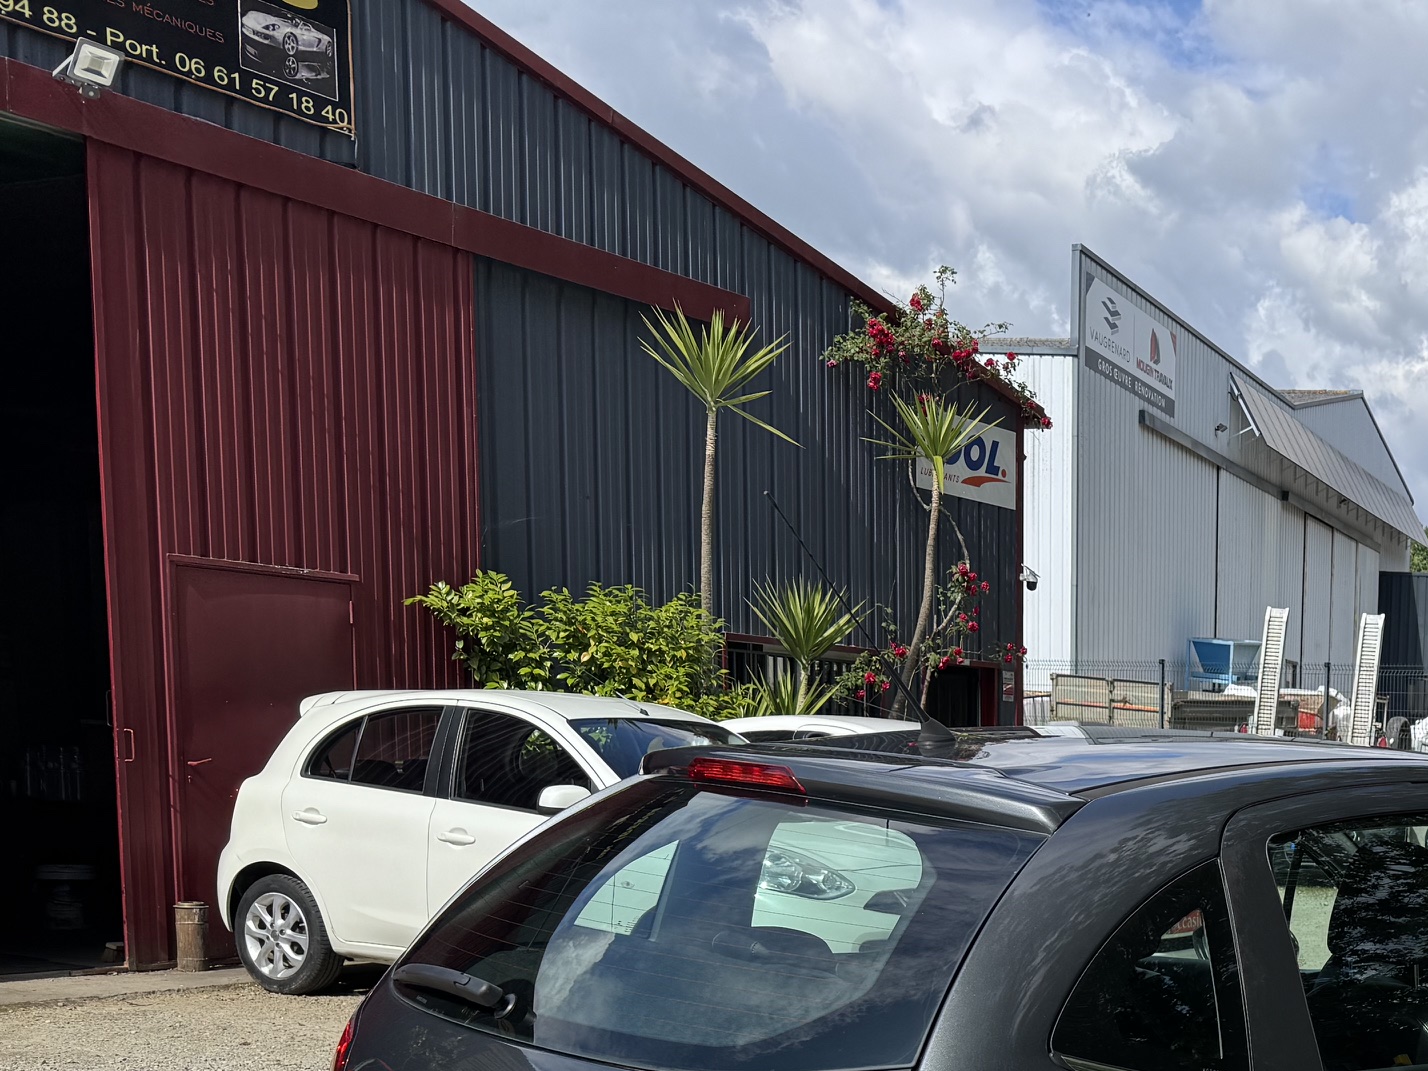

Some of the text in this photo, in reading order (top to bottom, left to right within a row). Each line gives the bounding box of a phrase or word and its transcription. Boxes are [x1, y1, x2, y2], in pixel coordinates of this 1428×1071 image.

[131, 1, 226, 44] MÉCANIQUES
[42, 6, 78, 34] 88
[105, 26, 167, 65] Port.
[174, 52, 206, 78] 06
[213, 65, 241, 91] 61
[251, 79, 280, 102] 57
[288, 92, 315, 115] 18
[321, 104, 350, 126] 40
[1089, 326, 1132, 363] VAUGRENARD
[1097, 358, 1113, 376] GROS
